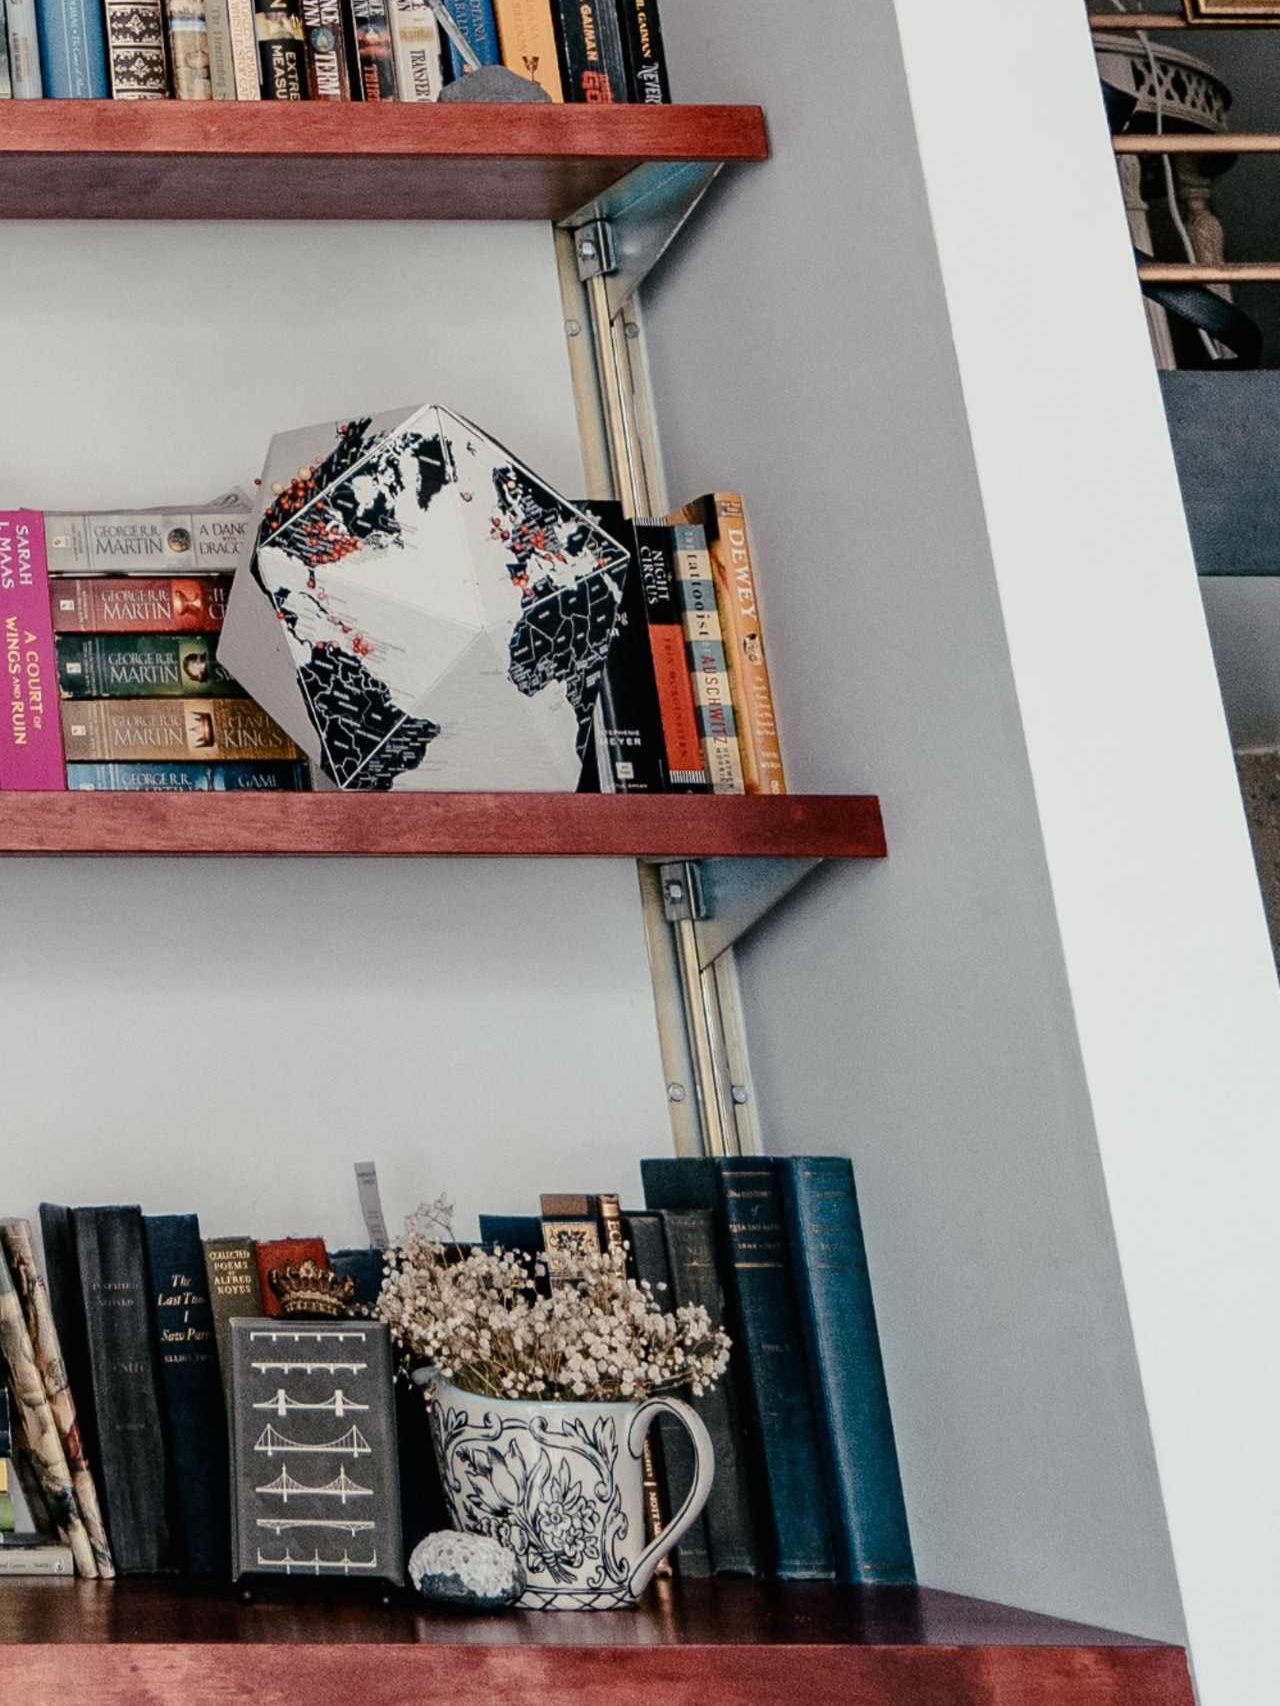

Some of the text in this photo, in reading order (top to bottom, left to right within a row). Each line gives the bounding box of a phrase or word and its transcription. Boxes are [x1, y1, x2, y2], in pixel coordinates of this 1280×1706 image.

[581, 5, 599, 61] GAIMAN
[15, 524, 33, 585] SARAH
[640, 546, 658, 605] CIRCUS
[653, 549, 670, 601] NIGHT
[728, 530, 757, 621] DEWEY
[4, 616, 27, 745] WINGS AND RUIN
[23, 630, 43, 730] A COURT OF
